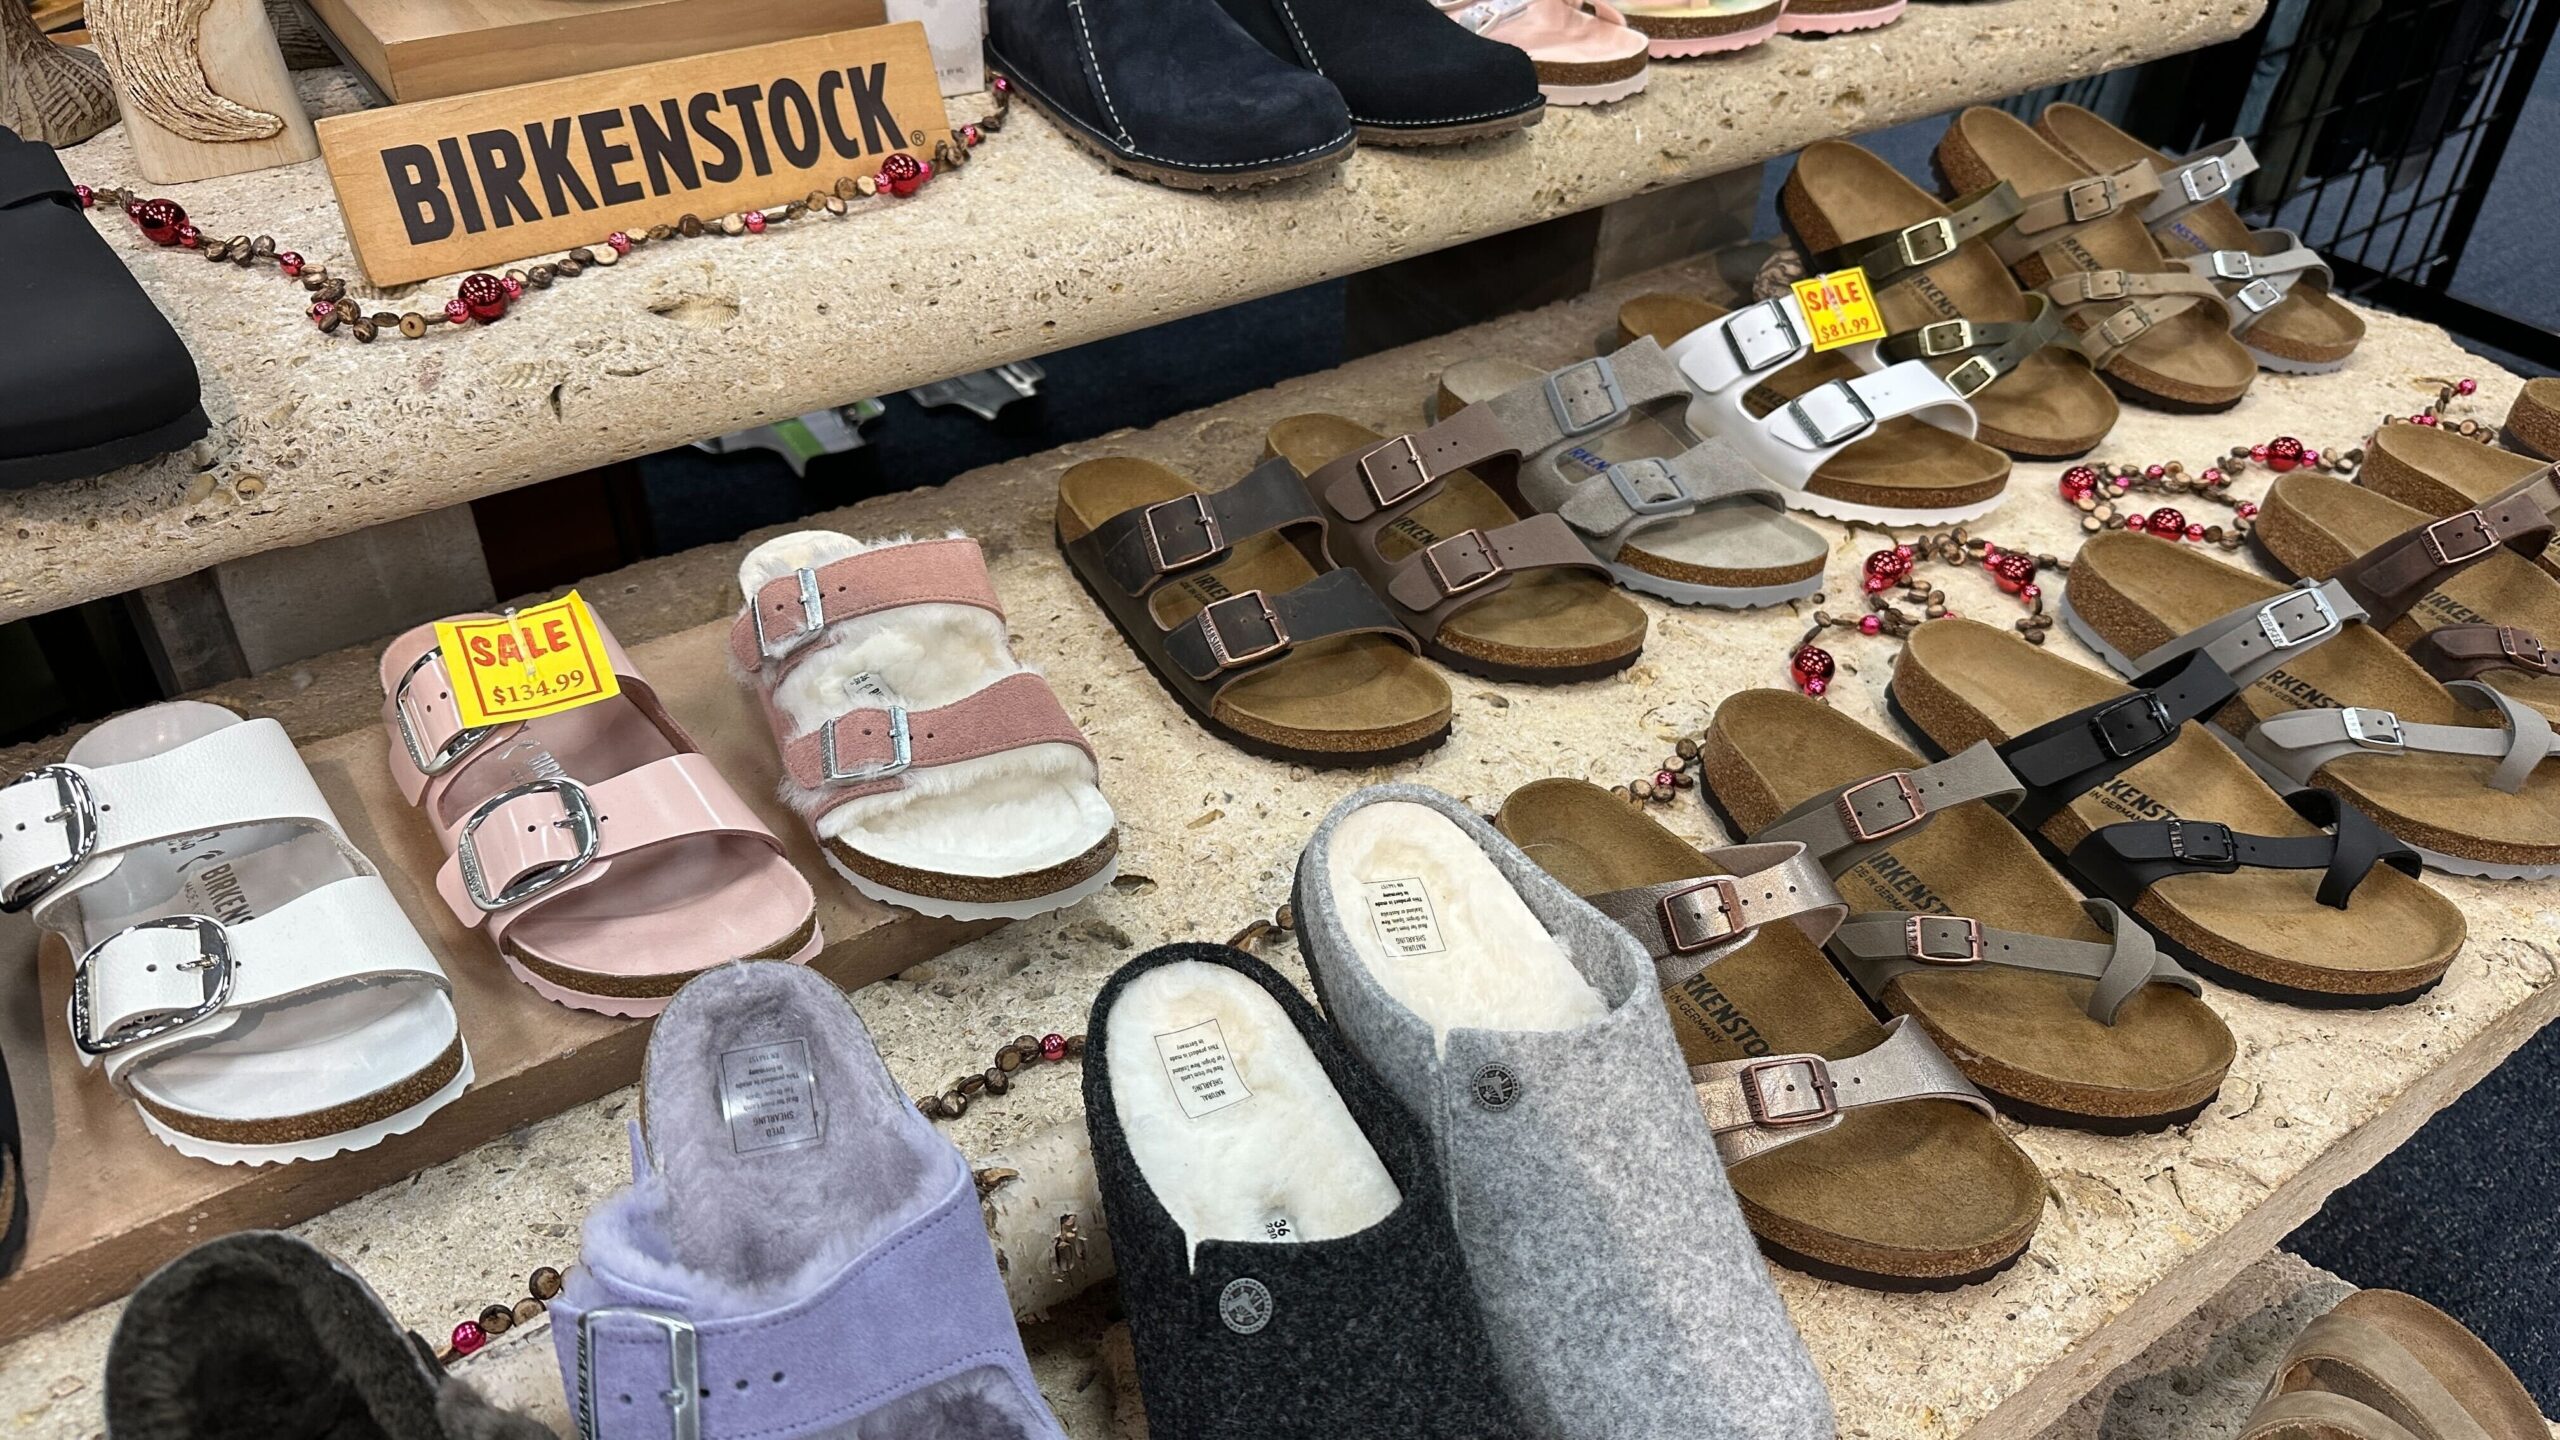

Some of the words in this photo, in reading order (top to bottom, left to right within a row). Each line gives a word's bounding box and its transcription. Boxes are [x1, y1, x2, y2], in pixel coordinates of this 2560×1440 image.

[381, 62, 909, 245] BIRKENSTOCK
[1806, 281, 1862, 312] SALE
[1821, 317, 1870, 342] $81.99
[470, 619, 571, 667] SALE
[492, 669, 585, 706] $134.99
[2088, 790, 2103, 800] IN
[1866, 877, 1876, 891] IN
[1394, 897, 1412, 905] product
[1395, 934, 1427, 945] SHEARLING
[1401, 944, 1427, 952] NATURAL
[1679, 1002, 1725, 1046] GERMANY
[1176, 1040, 1198, 1050] Germany
[1189, 1046, 1207, 1058] product
[1208, 1043, 1219, 1051] This
[1169, 1054, 1183, 1062] made
[1191, 1077, 1224, 1093] SHEARLING
[1200, 1089, 1226, 1102] NATURAL
[1746, 1073, 1763, 1118] BIRKEN
[753, 1110, 794, 1126] SHEARLING
[766, 1126, 785, 1138] DYED
[1265, 1222, 1278, 1240] 230
[1274, 1219, 1291, 1237] 36
